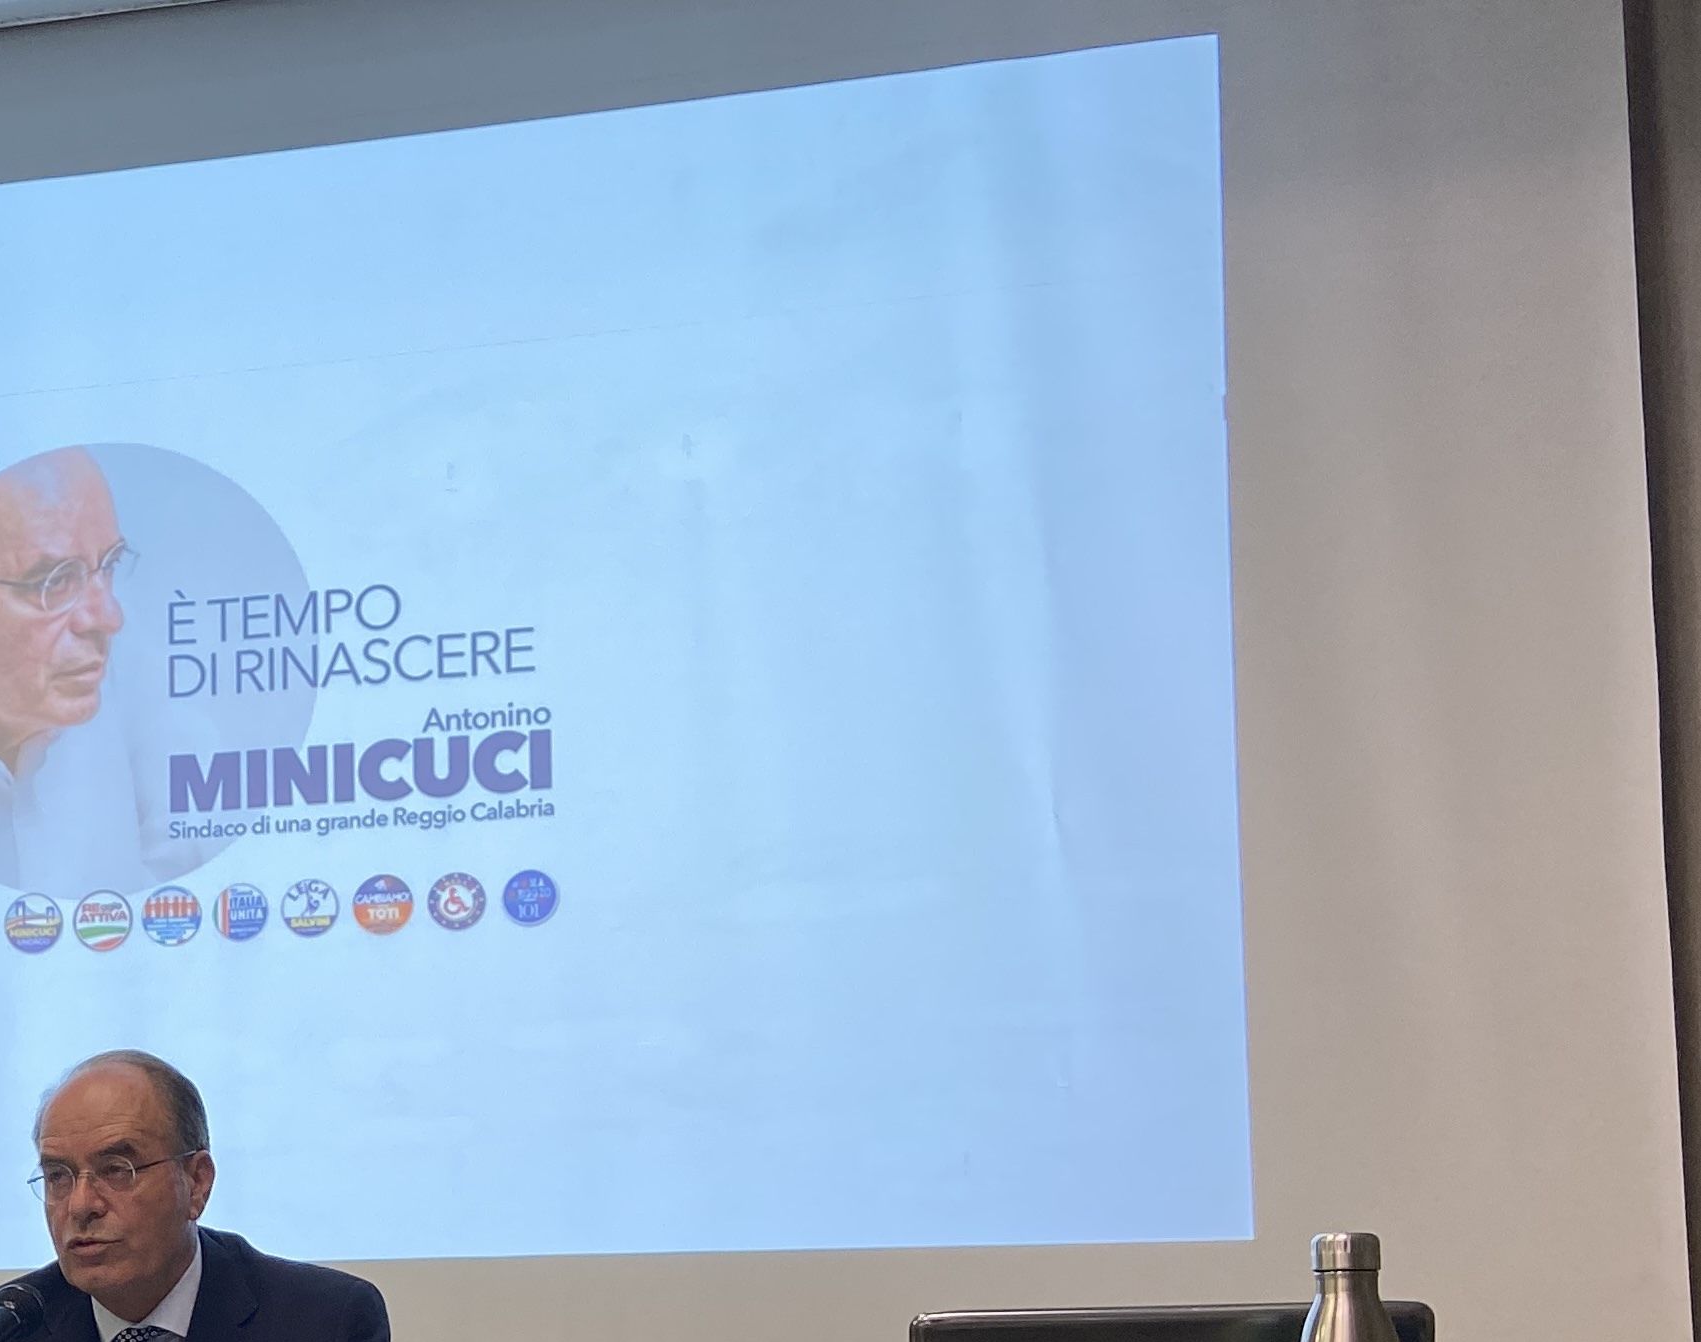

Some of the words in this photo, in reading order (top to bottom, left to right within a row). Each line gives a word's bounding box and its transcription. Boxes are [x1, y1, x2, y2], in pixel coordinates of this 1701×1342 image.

[168, 589, 197, 646] È
[206, 583, 402, 643] TEMPO
[168, 652, 218, 698] DI
[235, 626, 537, 695] RINASCERE
[421, 701, 552, 733] Antonino
[168, 728, 553, 814] MINICUCI
[168, 818, 248, 840] Sindaco
[251, 814, 271, 835] di
[275, 817, 312, 834] una
[315, 807, 389, 836] grande
[392, 803, 466, 830] Reggio
[469, 798, 556, 822] Calabria
[79, 911, 128, 923] ATTIVA
